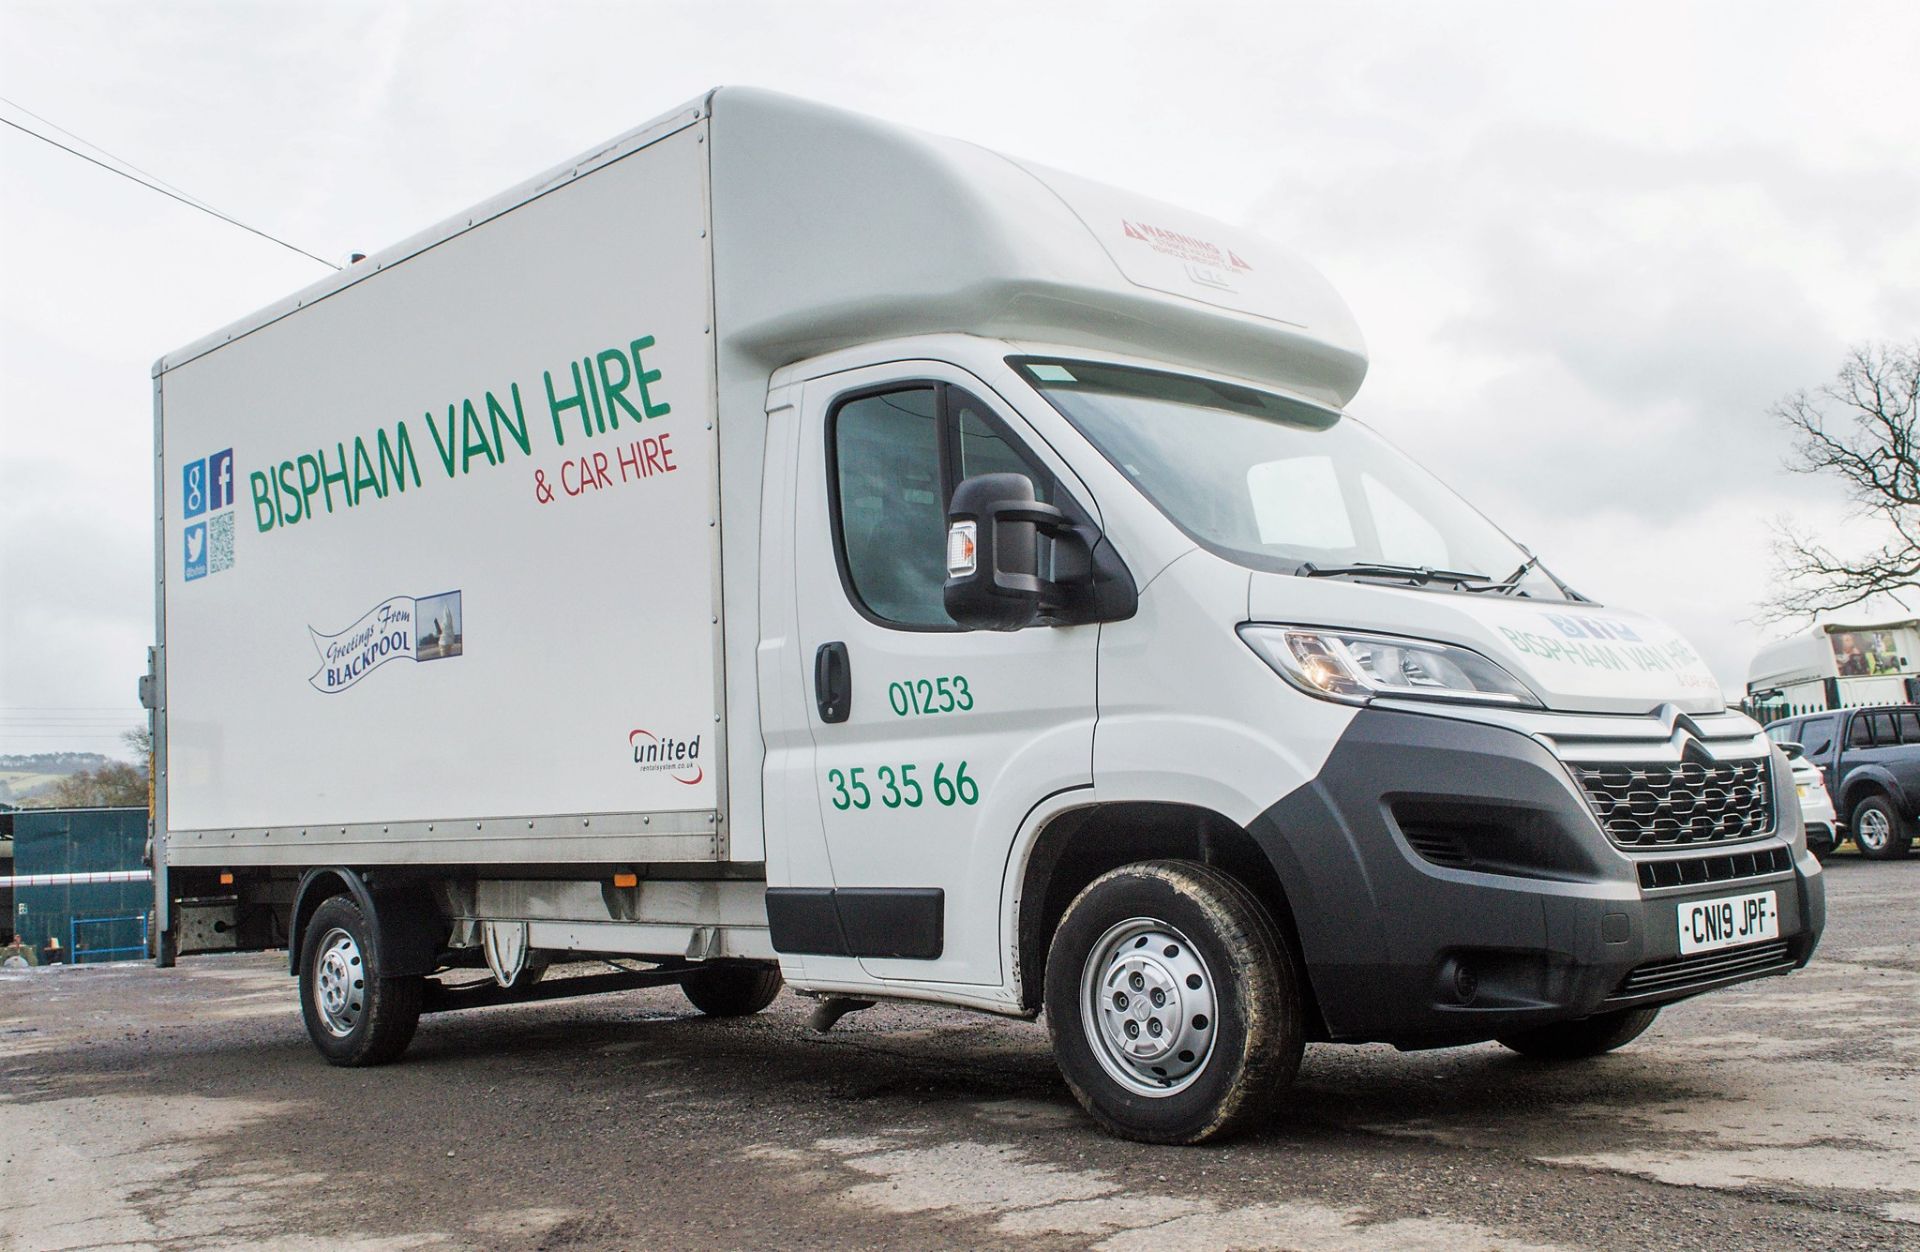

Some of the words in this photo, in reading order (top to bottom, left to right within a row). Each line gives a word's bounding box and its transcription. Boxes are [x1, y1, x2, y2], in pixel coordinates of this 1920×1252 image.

[1136, 222, 1221, 254] WARNING
[250, 420, 421, 533] BISPHAM
[425, 382, 532, 478] VAN
[543, 335, 671, 446] HIRE
[534, 469, 555, 504] &
[560, 451, 613, 496] CAR
[619, 432, 678, 484] HIRE
[326, 624, 374, 664] Greetings
[377, 605, 410, 634] From
[327, 631, 411, 687] BLACKPOOL
[1498, 625, 1629, 671] BISPHAM
[1623, 646, 1674, 671] VAN
[888, 675, 975, 717] 01253
[633, 734, 701, 764] united
[828, 767, 872, 811] 35
[877, 764, 924, 809] 35
[933, 760, 980, 807] 66
[1692, 903, 1734, 944] CN19
[1739, 897, 1767, 936] JPF
